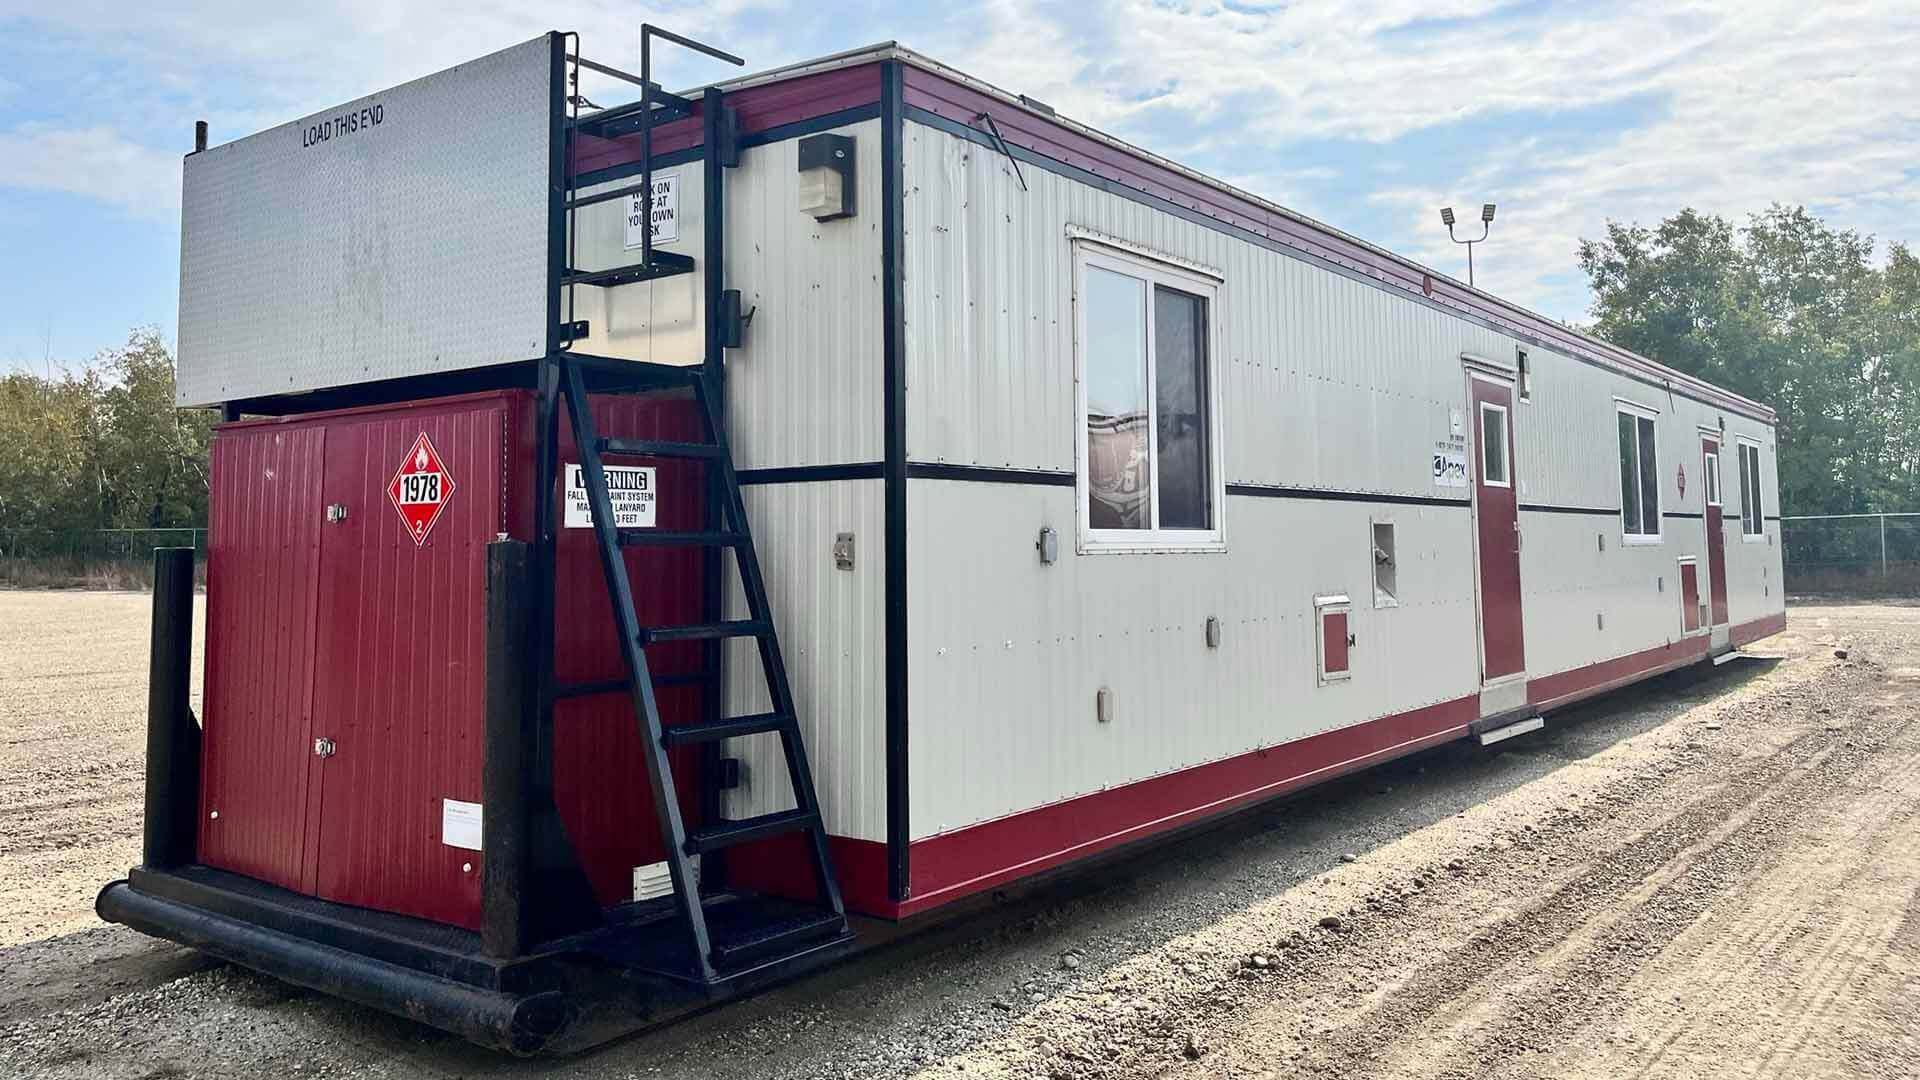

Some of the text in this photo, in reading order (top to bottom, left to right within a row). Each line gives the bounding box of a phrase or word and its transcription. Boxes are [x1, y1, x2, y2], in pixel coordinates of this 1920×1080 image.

[303, 103, 384, 148] LOAD THIS END
[657, 181, 671, 194] ON
[656, 195, 668, 209] AT
[652, 207, 674, 223] OWN
[648, 224, 660, 237] SK
[403, 474, 439, 502] 1978
[567, 490, 585, 500] FALL
[627, 491, 654, 502] SYSTEM
[615, 503, 646, 513] LANYARD
[622, 514, 637, 523] FEET
[416, 519, 423, 534] 2
